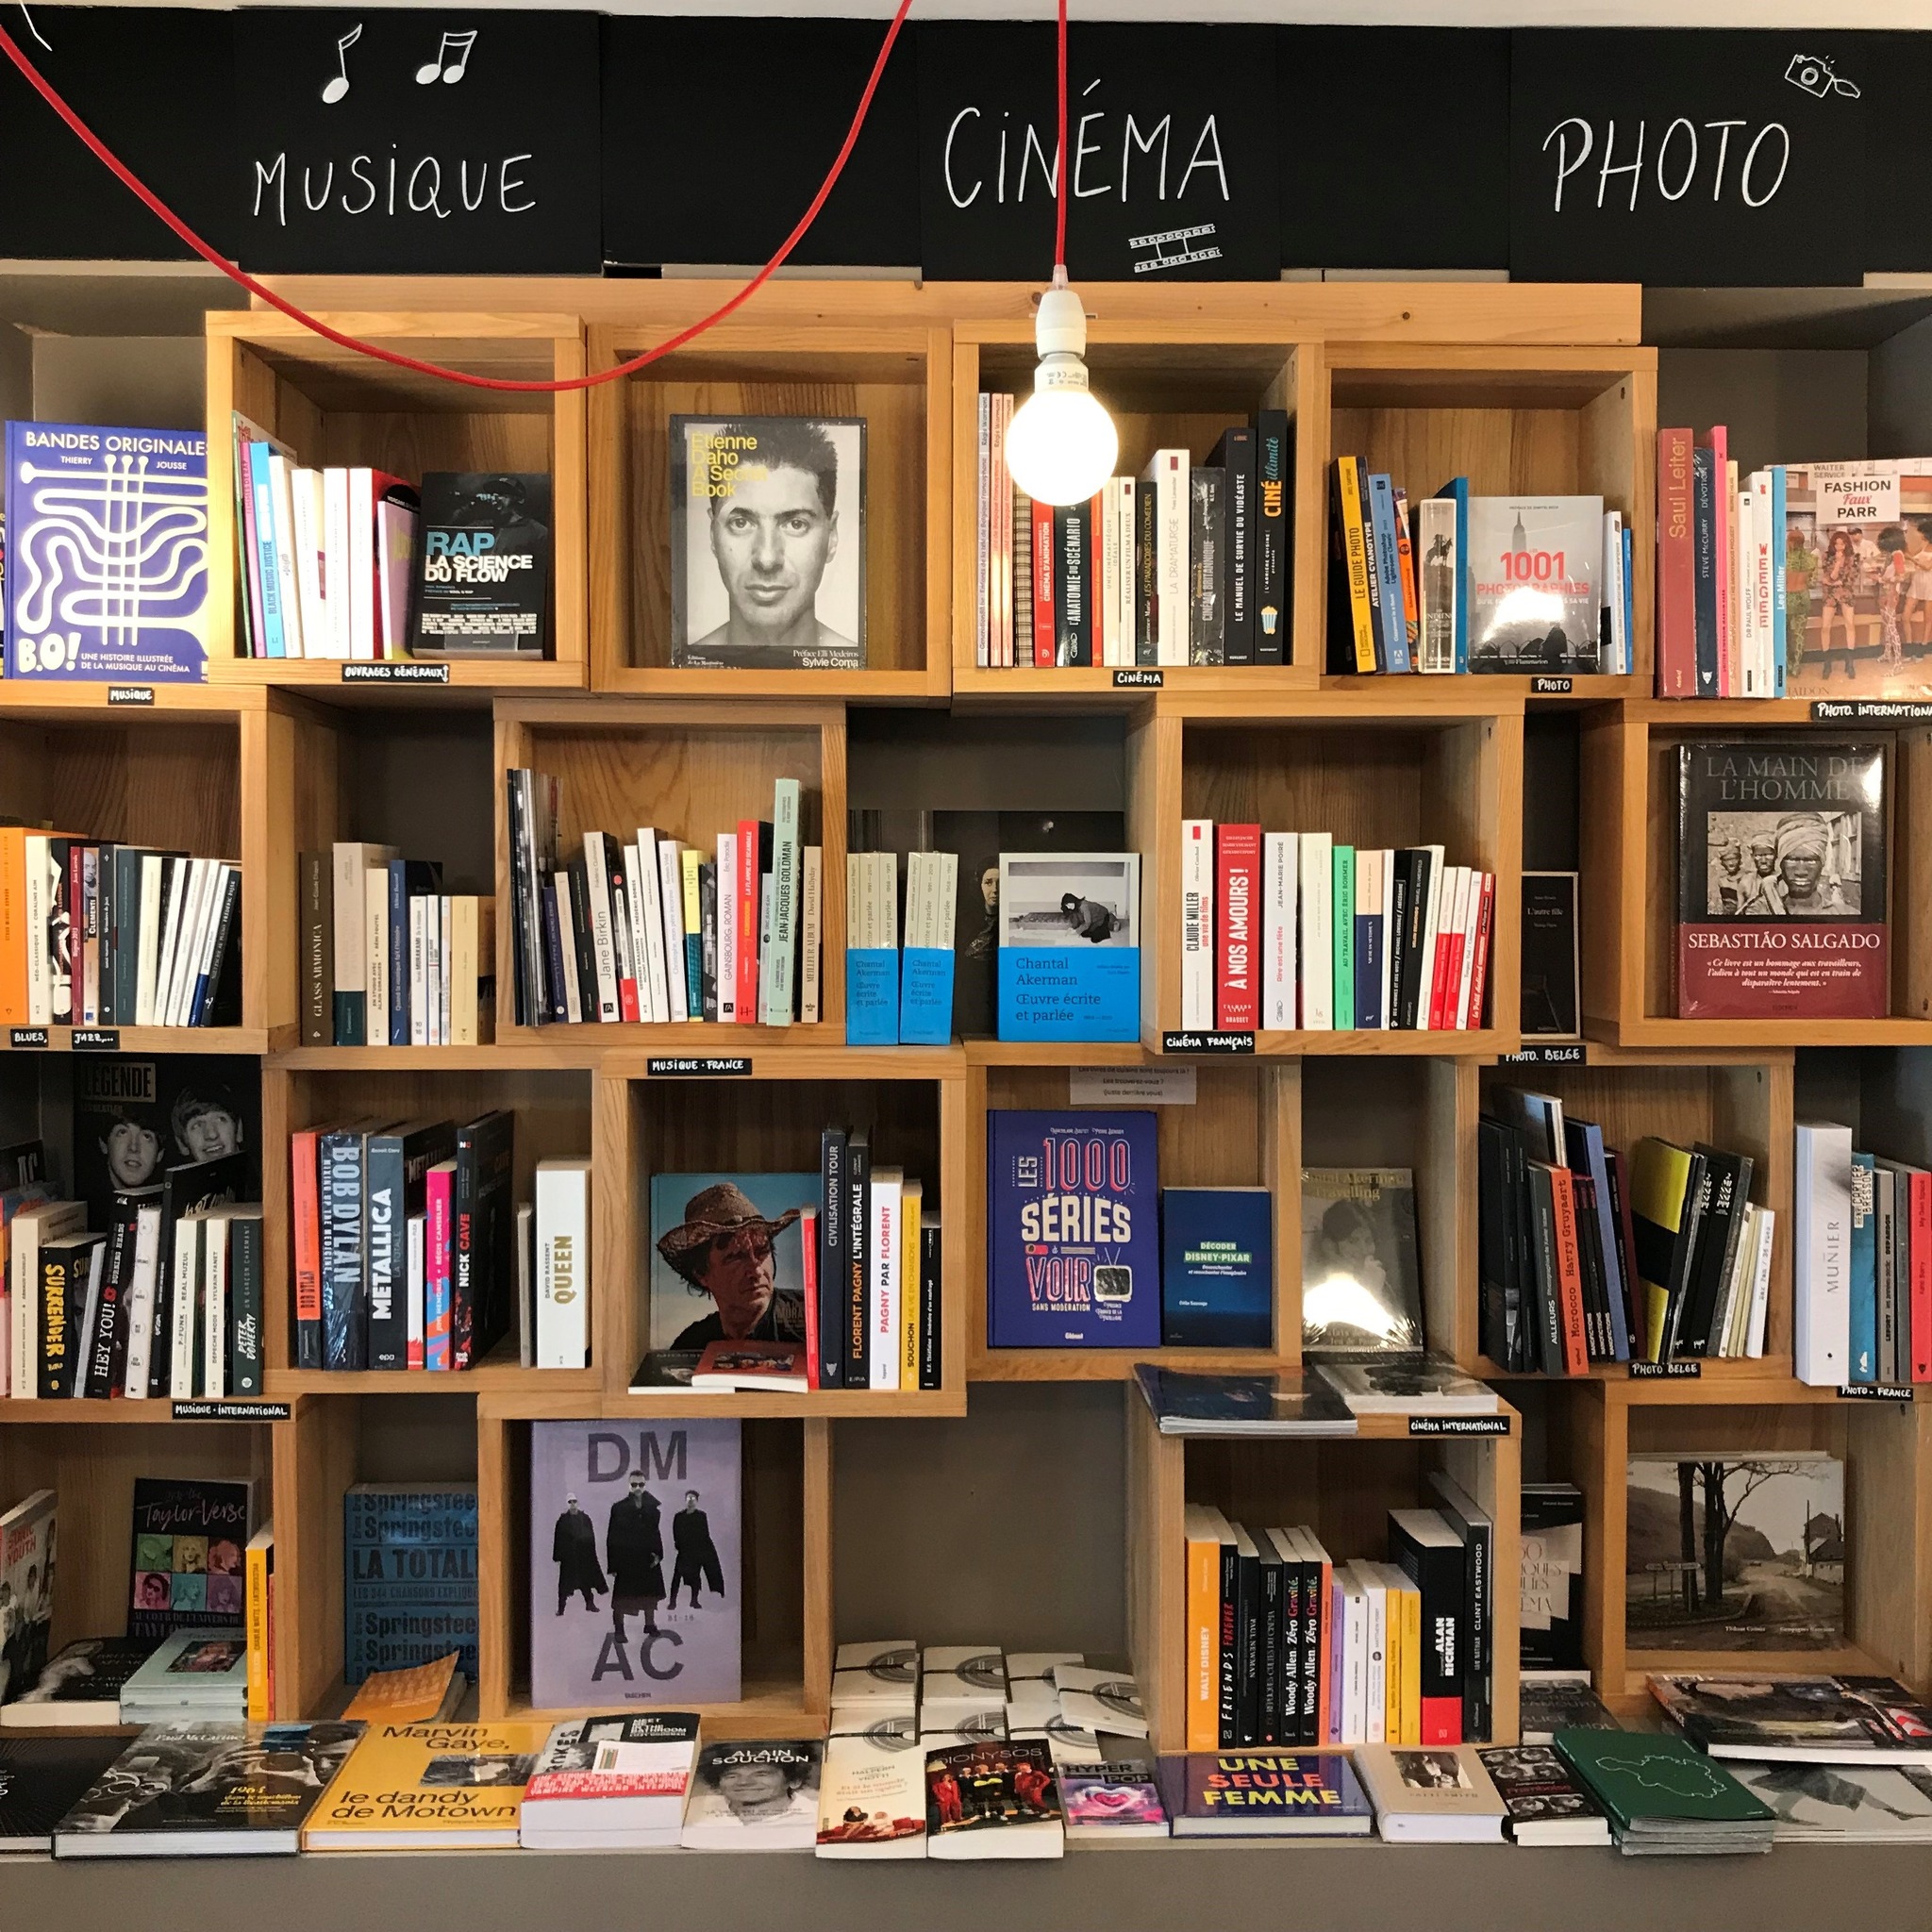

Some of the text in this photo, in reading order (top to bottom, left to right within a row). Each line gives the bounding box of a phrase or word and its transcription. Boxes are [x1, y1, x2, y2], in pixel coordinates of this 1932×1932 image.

[1542, 117, 1790, 211] PHOTO
[26, 431, 100, 451] BANDES
[61, 456, 187, 470] THIERRY JOUSSE
[691, 449, 739, 466] Daho
[1267, 437, 1278, 480] illimité
[691, 481, 737, 497] Book
[1234, 474, 1244, 513] VIDÉASTE
[1669, 437, 1686, 539] Saul Leiter
[1824, 480, 1890, 492] FASHION
[1261, 480, 1281, 517] CINÉ
[1843, 493, 1873, 505] Faux
[1236, 518, 1243, 527] DU
[1837, 507, 1877, 518] PARR
[426, 532, 495, 556] RAP
[425, 556, 533, 569] LA SCIENCE
[1236, 559, 1243, 570] DE
[1349, 527, 1365, 599] LE GUIDE PHOTO
[1364, 522, 1379, 608] ATELIER CYANOTYPE
[1500, 552, 1564, 580] 1001
[425, 569, 508, 582] DU FLOW
[1235, 574, 1243, 605] MANUEL
[1235, 609, 1243, 622] LE
[81, 653, 174, 663] UNE HISTOIRE ILLUSTRÉE
[802, 658, 858, 667] Sylvie Coma
[345, 666, 391, 678] OUVRAGES
[1538, 679, 1570, 691] PHOTO
[1706, 757, 1866, 776] LA MAIN DE
[1721, 779, 1852, 800] L'HOMME
[778, 841, 792, 943] JEAN-JACQUES GOLDMAN
[1186, 891, 1199, 952] CLAUDE MILLER
[596, 910, 611, 979] Jane Birkin
[1688, 930, 1880, 949] SEBASTIÃO SALGADO
[312, 924, 323, 1017] GLASS ARMONICA
[1016, 958, 1069, 970] Chantal
[1228, 944, 1248, 975] NOS
[1016, 974, 1078, 986] Akerman
[1224, 977, 1248, 991] À
[1016, 993, 1101, 1006] Œuvre écrite
[1016, 1009, 1074, 1024] et parlée
[15, 1032, 47, 1043] BLUES,
[708, 1059, 743, 1070] FRANCE
[1544, 1048, 1580, 1061] BELGE
[1018, 1138, 1131, 1191] LES 1000
[828, 1145, 839, 1247] CIVILISATION TOUR
[1853, 1164, 1863, 1205] CARTIER
[1862, 1170, 1873, 1212] BRESSON
[332, 1145, 361, 1283] BOB DYLAN
[1021, 1192, 1131, 1242] SÉRIES
[371, 1188, 391, 1320] METALLICA
[458, 1213, 471, 1288] NICK CAVE
[1184, 1253, 1250, 1262] DISNEY-PIXAR
[1200, 1241, 1237, 1250] DÉCODER
[554, 1235, 576, 1305] QUEEN
[880, 1206, 891, 1334] PAGNY PAR FLORENT
[1557, 1179, 1580, 1338] Morocco Harry Gruyaert
[852, 1183, 862, 1359] FLORENT PAGNY L'INTÉGRALE
[1025, 1257, 1091, 1302] VOIR
[45, 1264, 65, 1357] SURRENDER
[1546, 1299, 1558, 1344] AILLEURS
[94, 1303, 116, 1378] HEY YOU!
[237, 1319, 248, 1354] PETER
[1632, 1363, 1697, 1374] PHOTO BELGE
[1878, 1388, 1911, 1398] FRANCE
[587, 1430, 688, 1483] DM
[364, 1493, 477, 1515] Springstee
[6, 1524, 34, 1550] SONIC
[365, 1516, 476, 1541] Springstee
[6, 1540, 37, 1566] YOUTH
[353, 1548, 478, 1579] LA TOTAL
[365, 1612, 477, 1638] Springstee
[1474, 1603, 1482, 1631] CLINT
[1435, 1617, 1444, 1652] ALAN
[1444, 1617, 1455, 1676] RICKMAN
[591, 1628, 685, 1682] AC
[1200, 1626, 1210, 1701] WALT DISNEY
[1222, 1603, 1234, 1721] FRIENDS FOREVER
[382, 1725, 488, 1738] Marvin
[425, 1738, 510, 1751] Gaye,
[712, 1755, 809, 1765] SOUCHON
[1066, 1764, 1132, 1774] HYPER
[1218, 1757, 1301, 1772] UNE
[1107, 1774, 1150, 1784] POP
[1208, 1774, 1324, 1788] SEULE
[340, 1790, 479, 1805] le dandy
[1202, 1790, 1342, 1807] FEMME
[331, 1806, 516, 1818] de Motown
